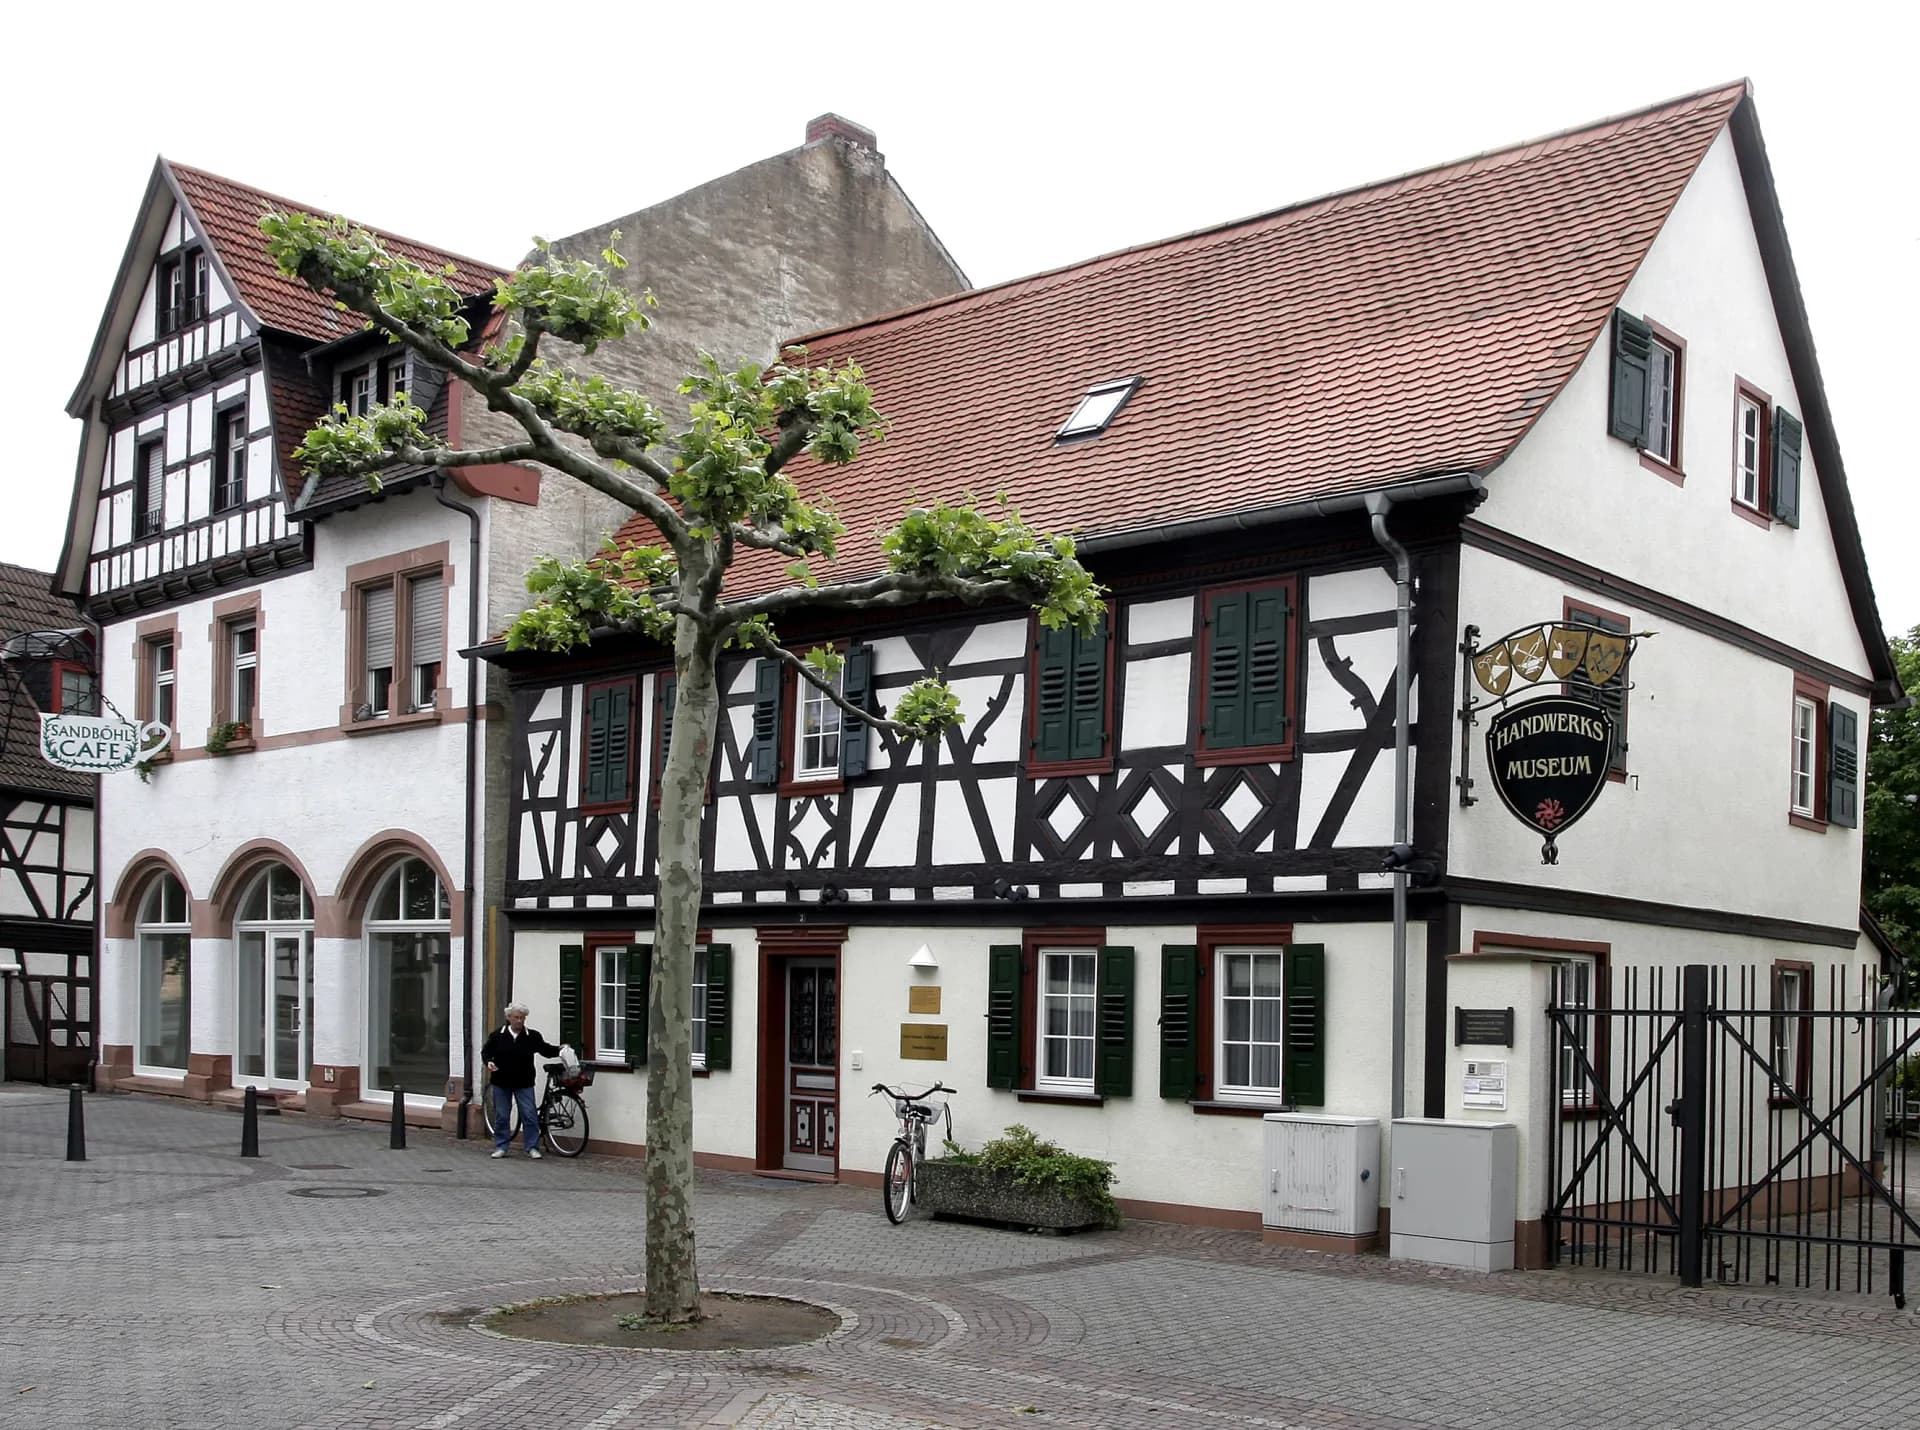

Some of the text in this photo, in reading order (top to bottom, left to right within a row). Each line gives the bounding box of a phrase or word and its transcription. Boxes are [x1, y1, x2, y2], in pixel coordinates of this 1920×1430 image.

[51, 724, 132, 742] SANDBÖHL
[1496, 712, 1604, 751] HANDWERKS
[60, 740, 121, 760] CAFE
[1506, 755, 1592, 780] MUSEUM
